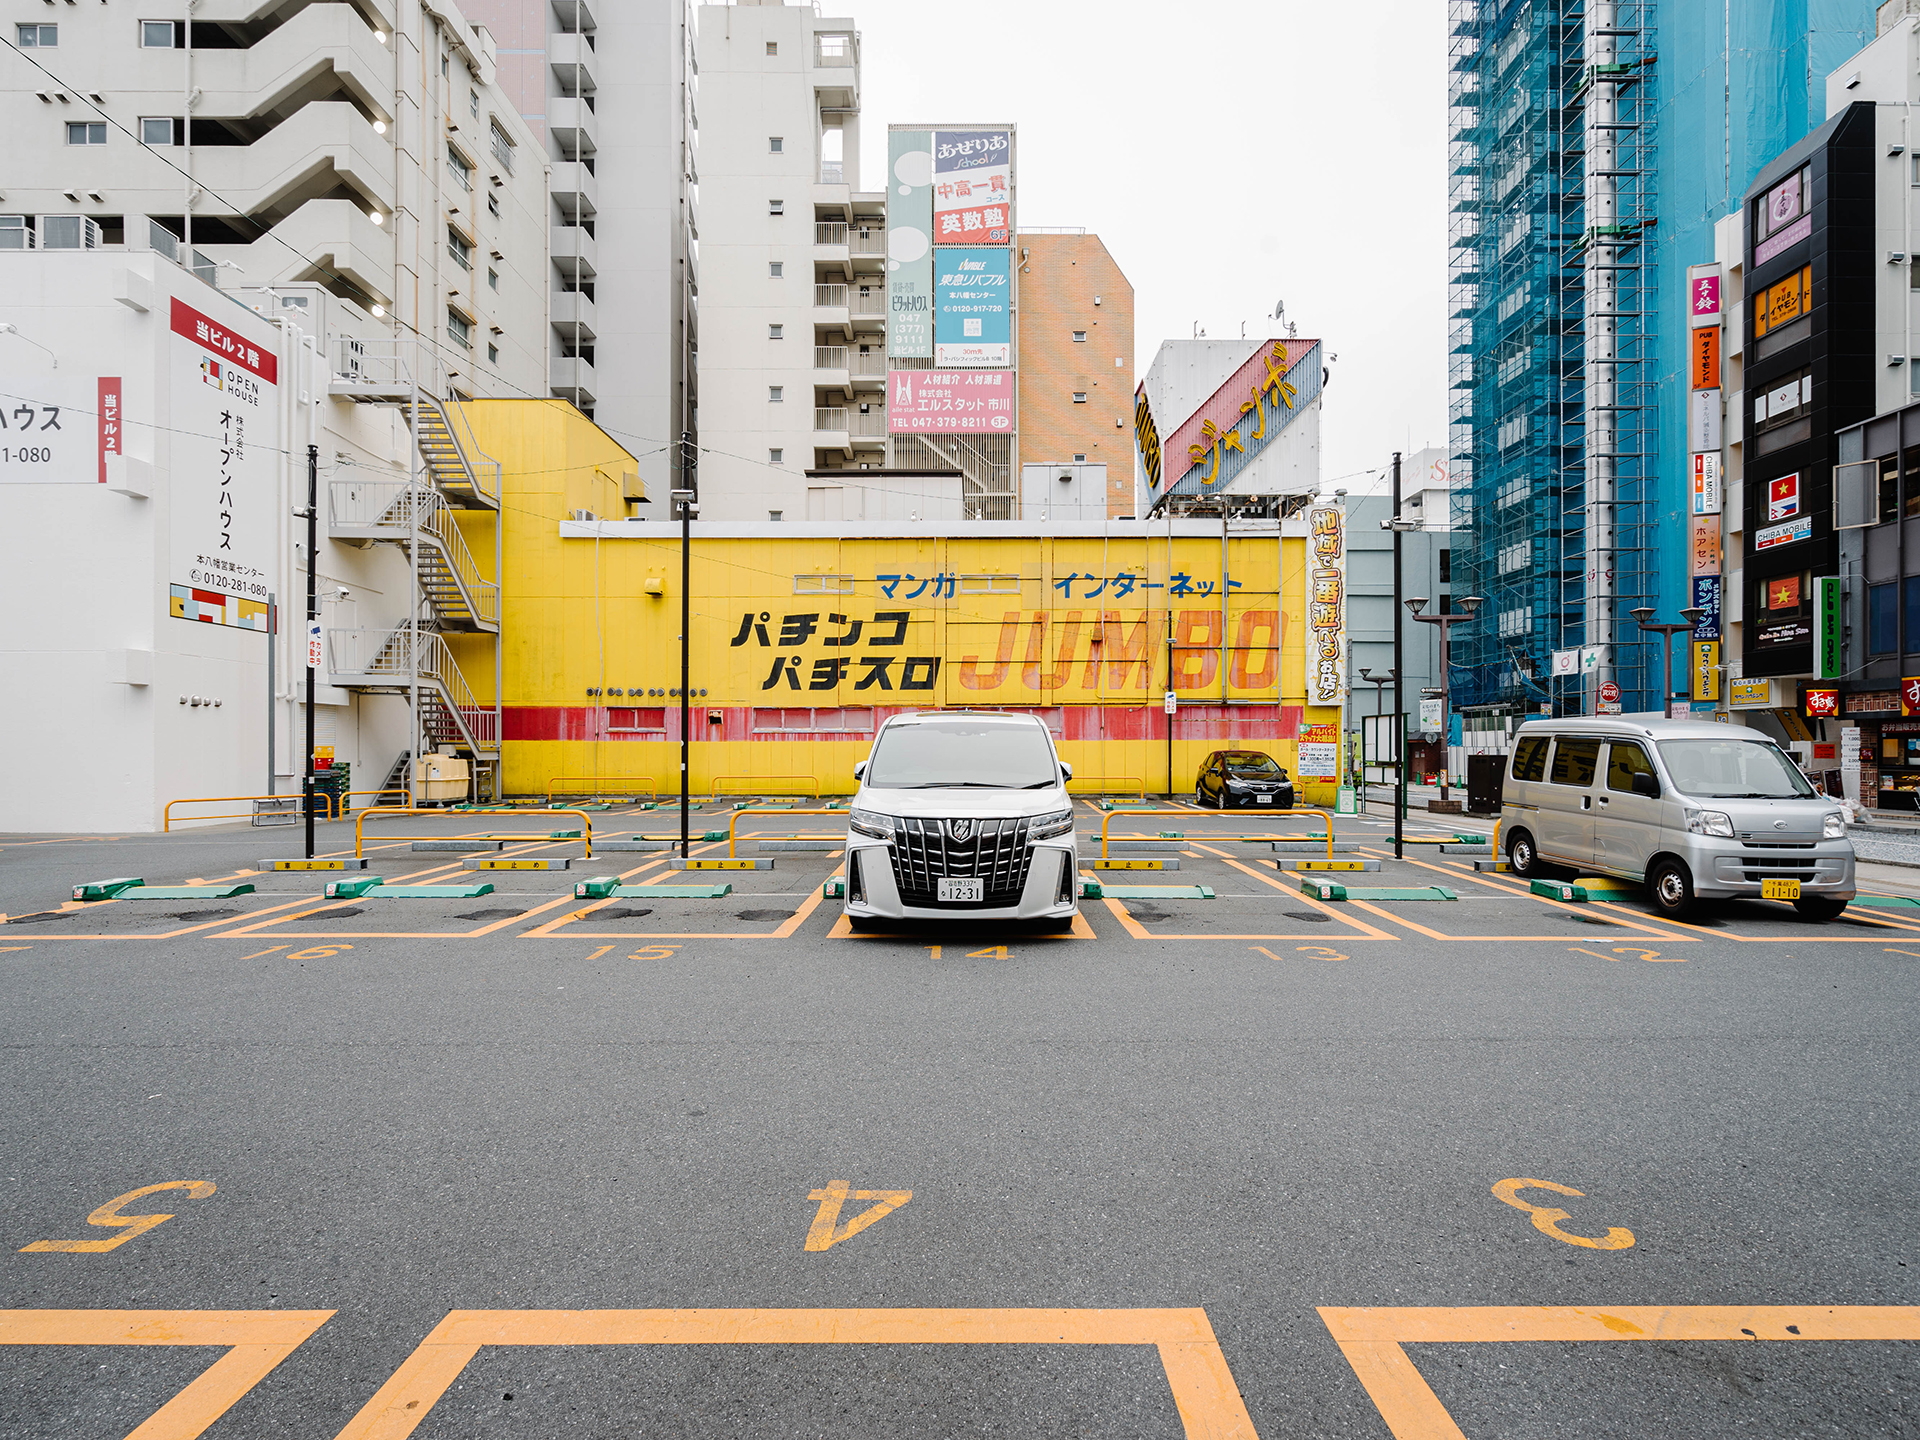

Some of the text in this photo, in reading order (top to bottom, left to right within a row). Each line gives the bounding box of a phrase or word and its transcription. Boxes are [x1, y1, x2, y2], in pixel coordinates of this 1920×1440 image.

[938, 135, 1007, 159] あぜりあ
[954, 153, 989, 170] School
[937, 174, 1007, 199] 中高一貫
[941, 207, 1005, 235] 英数塾
[990, 230, 1007, 240] 6F
[892, 295, 928, 311] ピタットハウス
[949, 291, 996, 299] 本八幡センター
[1776, 291, 1791, 304] PUB
[899, 314, 921, 322] 047
[895, 324, 924, 334] (377)
[196, 320, 260, 369] 当ビル2階
[895, 335, 923, 344] 9111
[1702, 341, 1710, 383] ダイヤモンド
[227, 371, 260, 395] OPEN
[923, 374, 1003, 385] 人材紹介 人材派遣
[228, 386, 260, 407] HOUSE
[919, 389, 952, 398] 株式会社
[917, 398, 1010, 412] エルスタット 市川
[1188, 341, 1298, 485] ジャンボ
[893, 418, 908, 427] TEL
[993, 418, 1007, 426] 5F
[236, 415, 244, 461] 株式会社
[219, 409, 235, 550] オープンハウス
[1705, 455, 1713, 509] CHIBA MOBILE
[1757, 530, 1781, 542] CHIBA
[1783, 521, 1812, 535] MOBILE
[1696, 528, 1707, 569] ホアセン
[196, 554, 265, 577] 本八幡営業センター
[204, 572, 267, 597] 0120-281-080
[876, 572, 956, 600] マンガ
[1054, 572, 1243, 599] インターネット
[730, 611, 910, 647] パチンコ
[959, 610, 1290, 690] JUMBO
[762, 655, 941, 691] パチスロ
[1809, 692, 1835, 709] すき家
[284, 862, 335, 870] 車止め
[489, 861, 541, 869] 車止め
[696, 861, 747, 869] 車止め
[1104, 861, 1154, 869] 車止め
[1305, 862, 1356, 870] 車止め
[949, 888, 979, 899] 12-31
[1772, 887, 1798, 897] 11-10
[240, 944, 355, 960] 16
[586, 945, 682, 960] 15
[924, 945, 1015, 960] 14
[1248, 946, 1350, 961] 13
[1567, 947, 1688, 962] 12
[18, 1180, 217, 1253] 5
[803, 1179, 913, 1251] 4
[1491, 1177, 1636, 1250] 3
